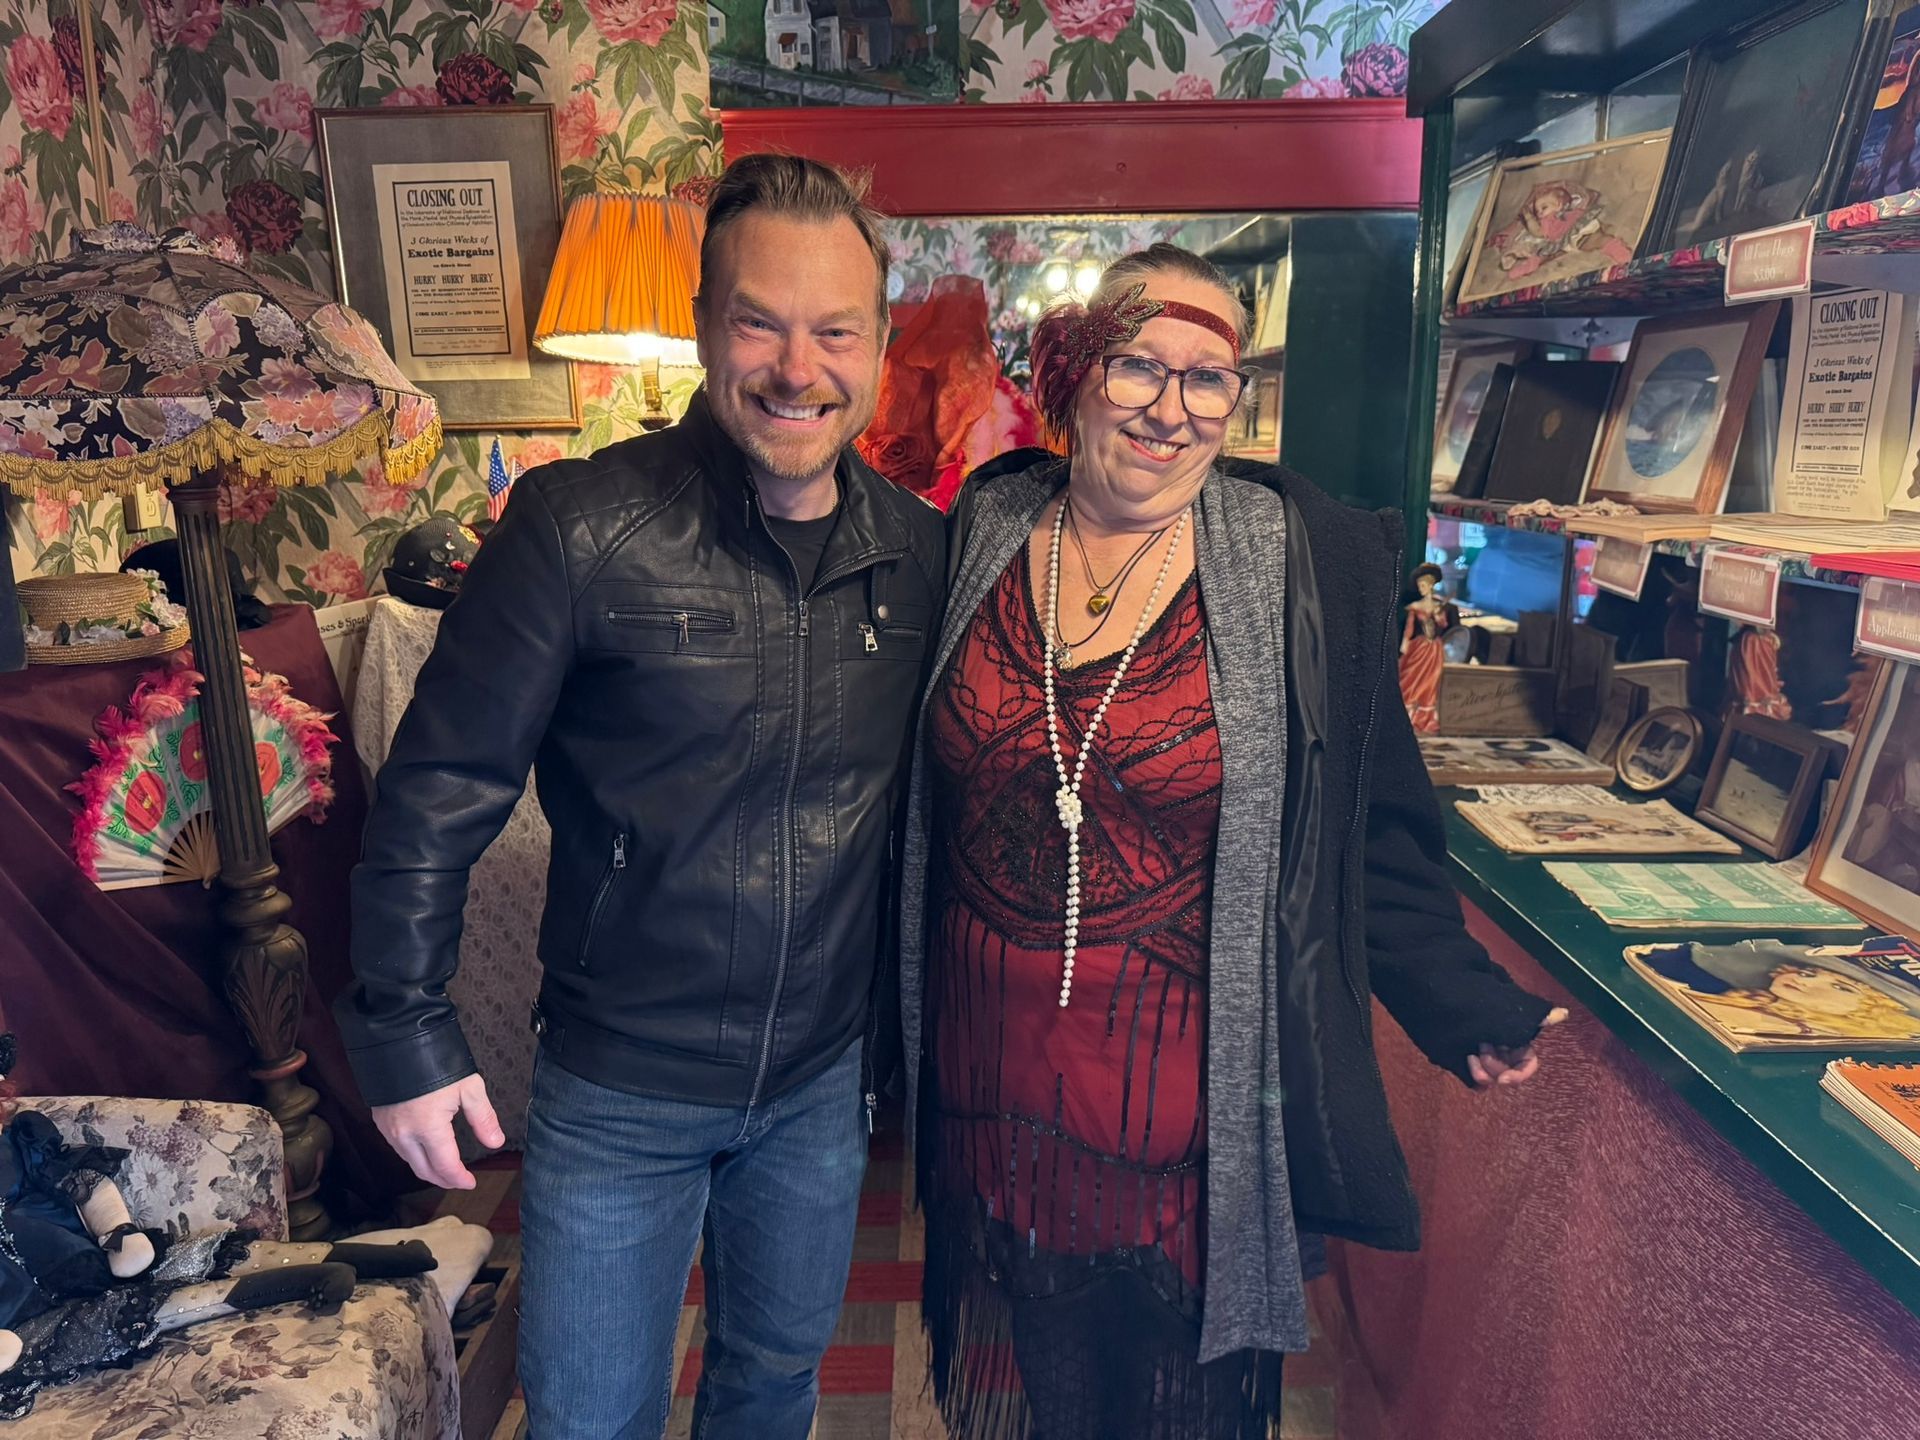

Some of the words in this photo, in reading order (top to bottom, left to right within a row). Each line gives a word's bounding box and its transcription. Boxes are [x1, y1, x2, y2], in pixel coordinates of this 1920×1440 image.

[407, 188, 456, 208] CLOSING
[459, 188, 484, 206] OUT
[410, 237, 417, 245] 3
[418, 236, 452, 245] Glorious
[454, 235, 478, 244] Weeks
[480, 235, 489, 245] of
[408, 248, 444, 259] Exotic
[446, 247, 495, 259] Bargains
[413, 275, 437, 285] HURRY
[442, 274, 465, 284] HURRY
[470, 273, 494, 283] HURRY
[1820, 299, 1857, 324] CLOSING
[1860, 296, 1879, 319] OUT
[1808, 371, 1837, 383] Exotic
[1838, 369, 1873, 383] Bargains
[320, 624, 336, 633] ses
